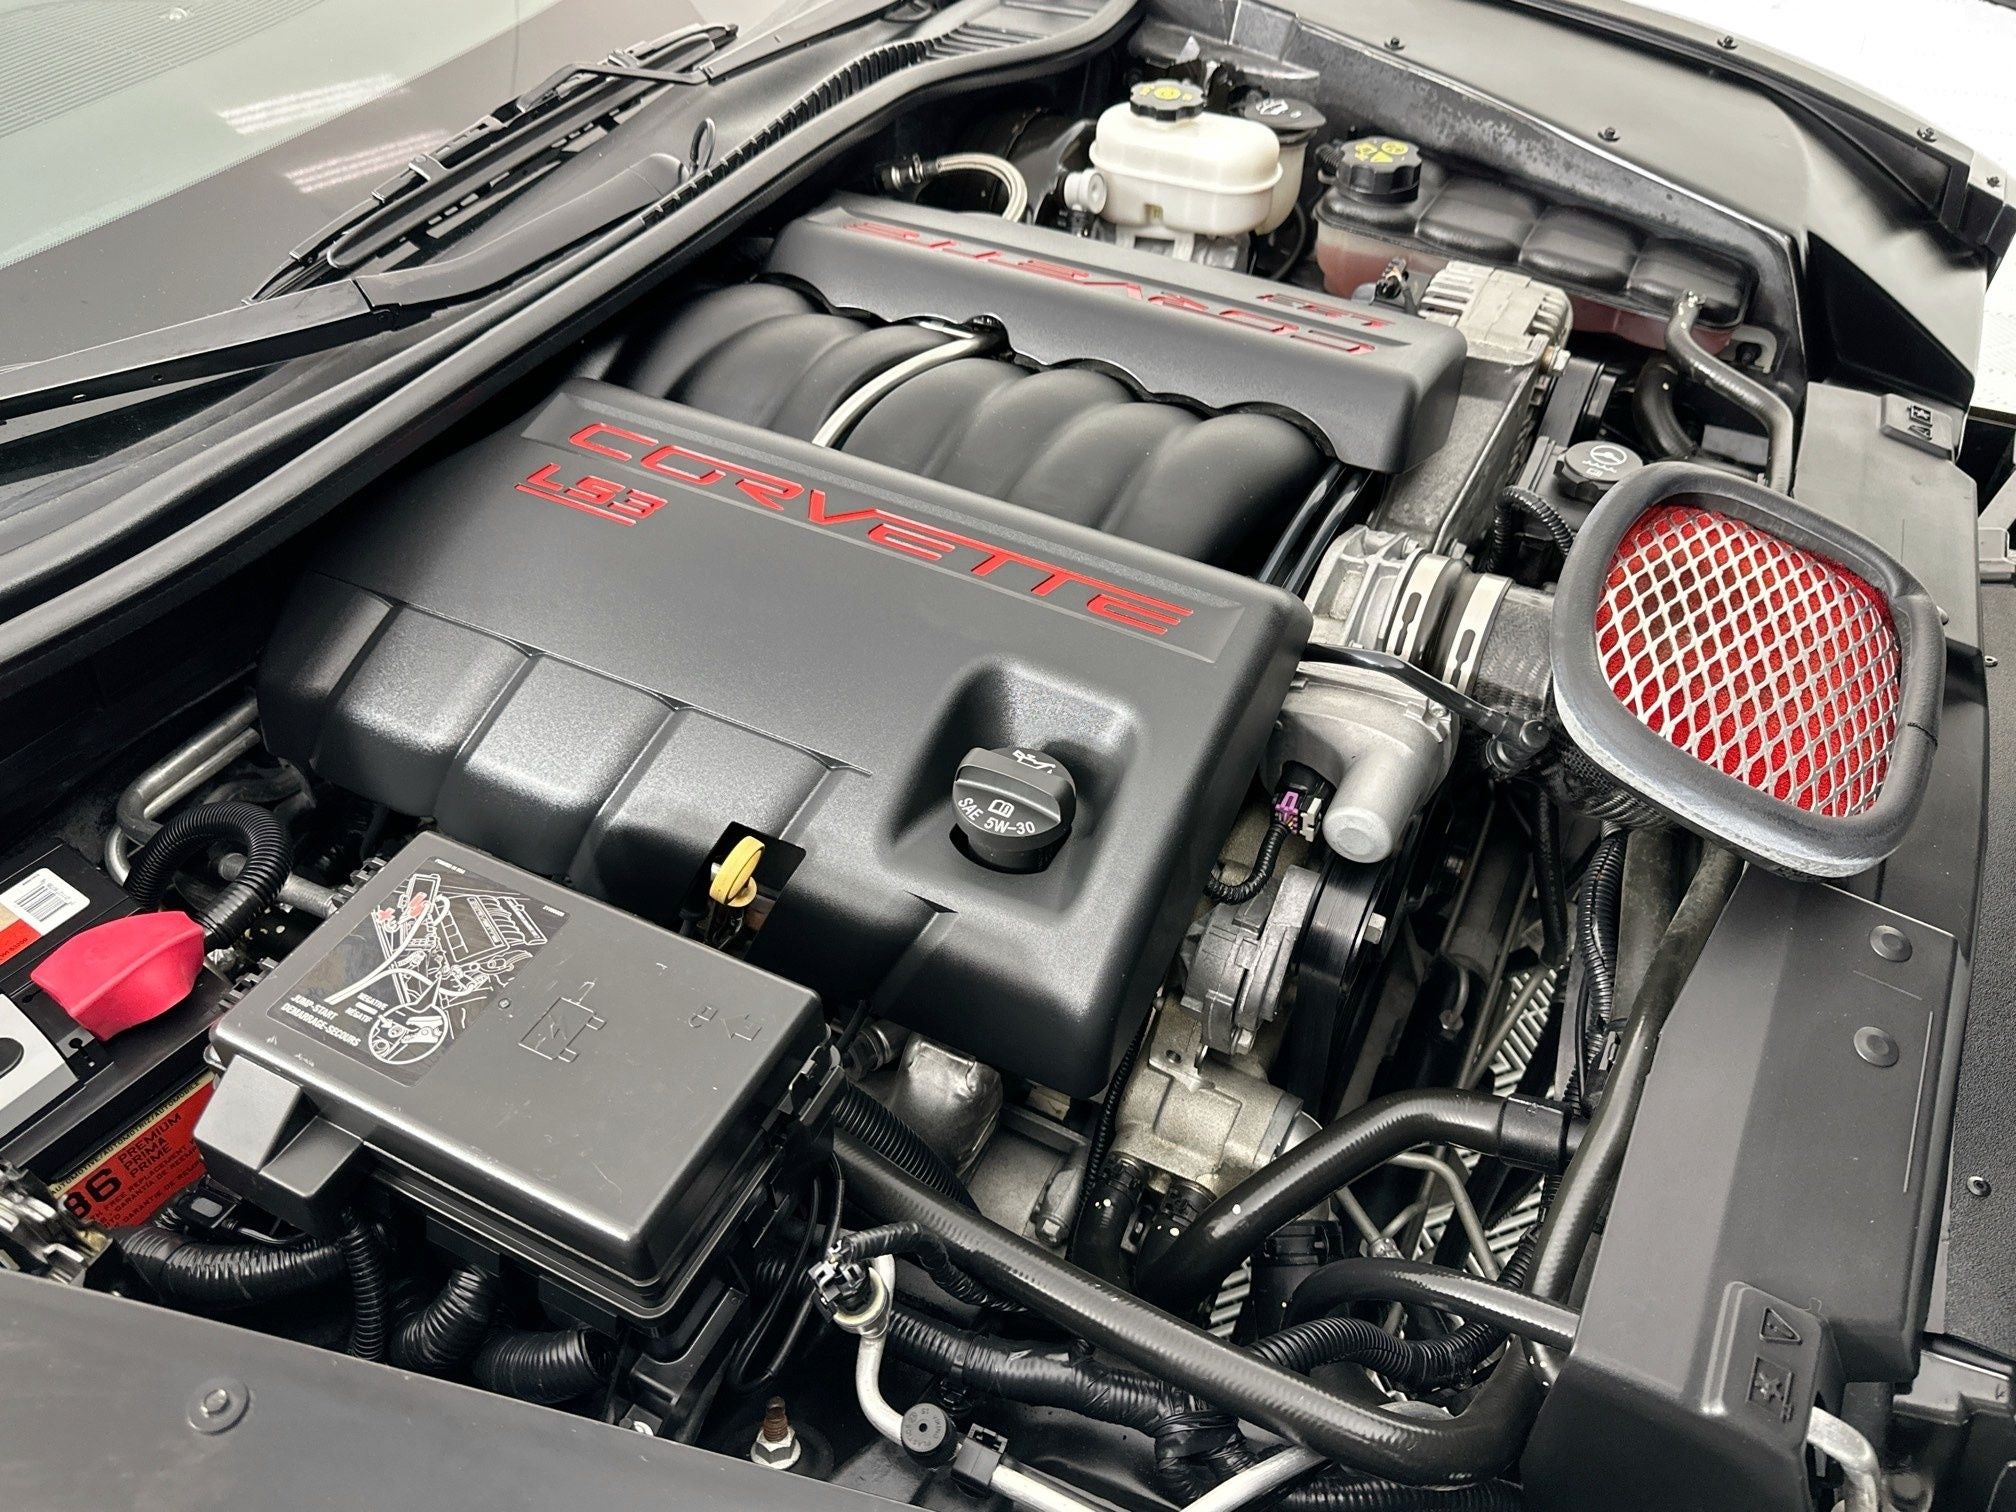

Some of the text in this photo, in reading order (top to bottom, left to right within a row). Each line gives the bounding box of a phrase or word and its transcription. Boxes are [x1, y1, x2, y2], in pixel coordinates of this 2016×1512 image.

[525, 462, 669, 522] LS3
[568, 422, 1193, 636] CORVETTE
[957, 797, 1036, 835] SAE 5W-30
[290, 994, 339, 1020] JUMP-START
[357, 992, 389, 1011] NEGATIVE
[281, 1003, 361, 1047] DEMARRAGE-SECOURS
[118, 1113, 182, 1164] PREMIUM
[123, 1136, 170, 1172] PRIMA
[127, 1144, 188, 1191] REPLACEMENT
[130, 1142, 173, 1179] PRIME
